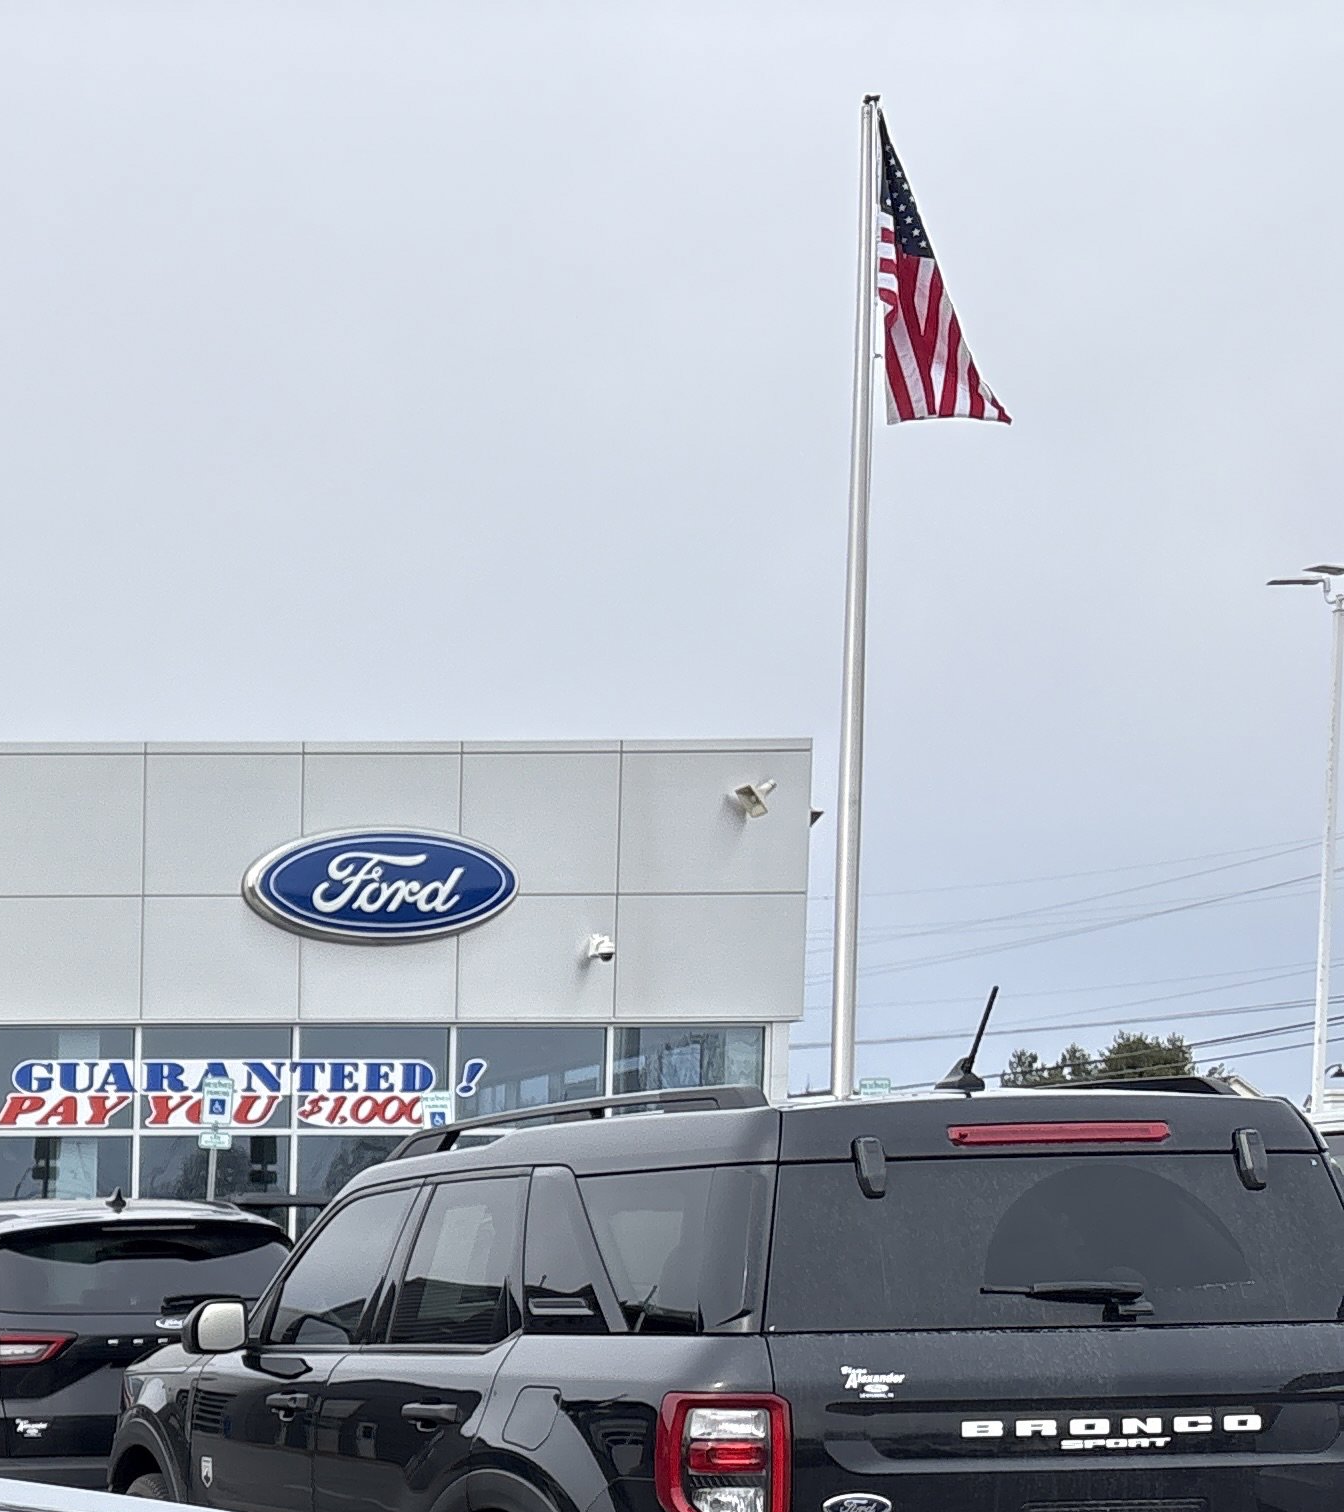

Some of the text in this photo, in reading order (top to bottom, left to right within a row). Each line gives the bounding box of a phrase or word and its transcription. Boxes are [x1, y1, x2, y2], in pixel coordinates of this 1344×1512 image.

[311, 851, 465, 913] Ford
[14, 1061, 434, 1094] GUARANTEED
[961, 1414, 1262, 1438] BRONCO
[1060, 1437, 1172, 1450] SPORT
